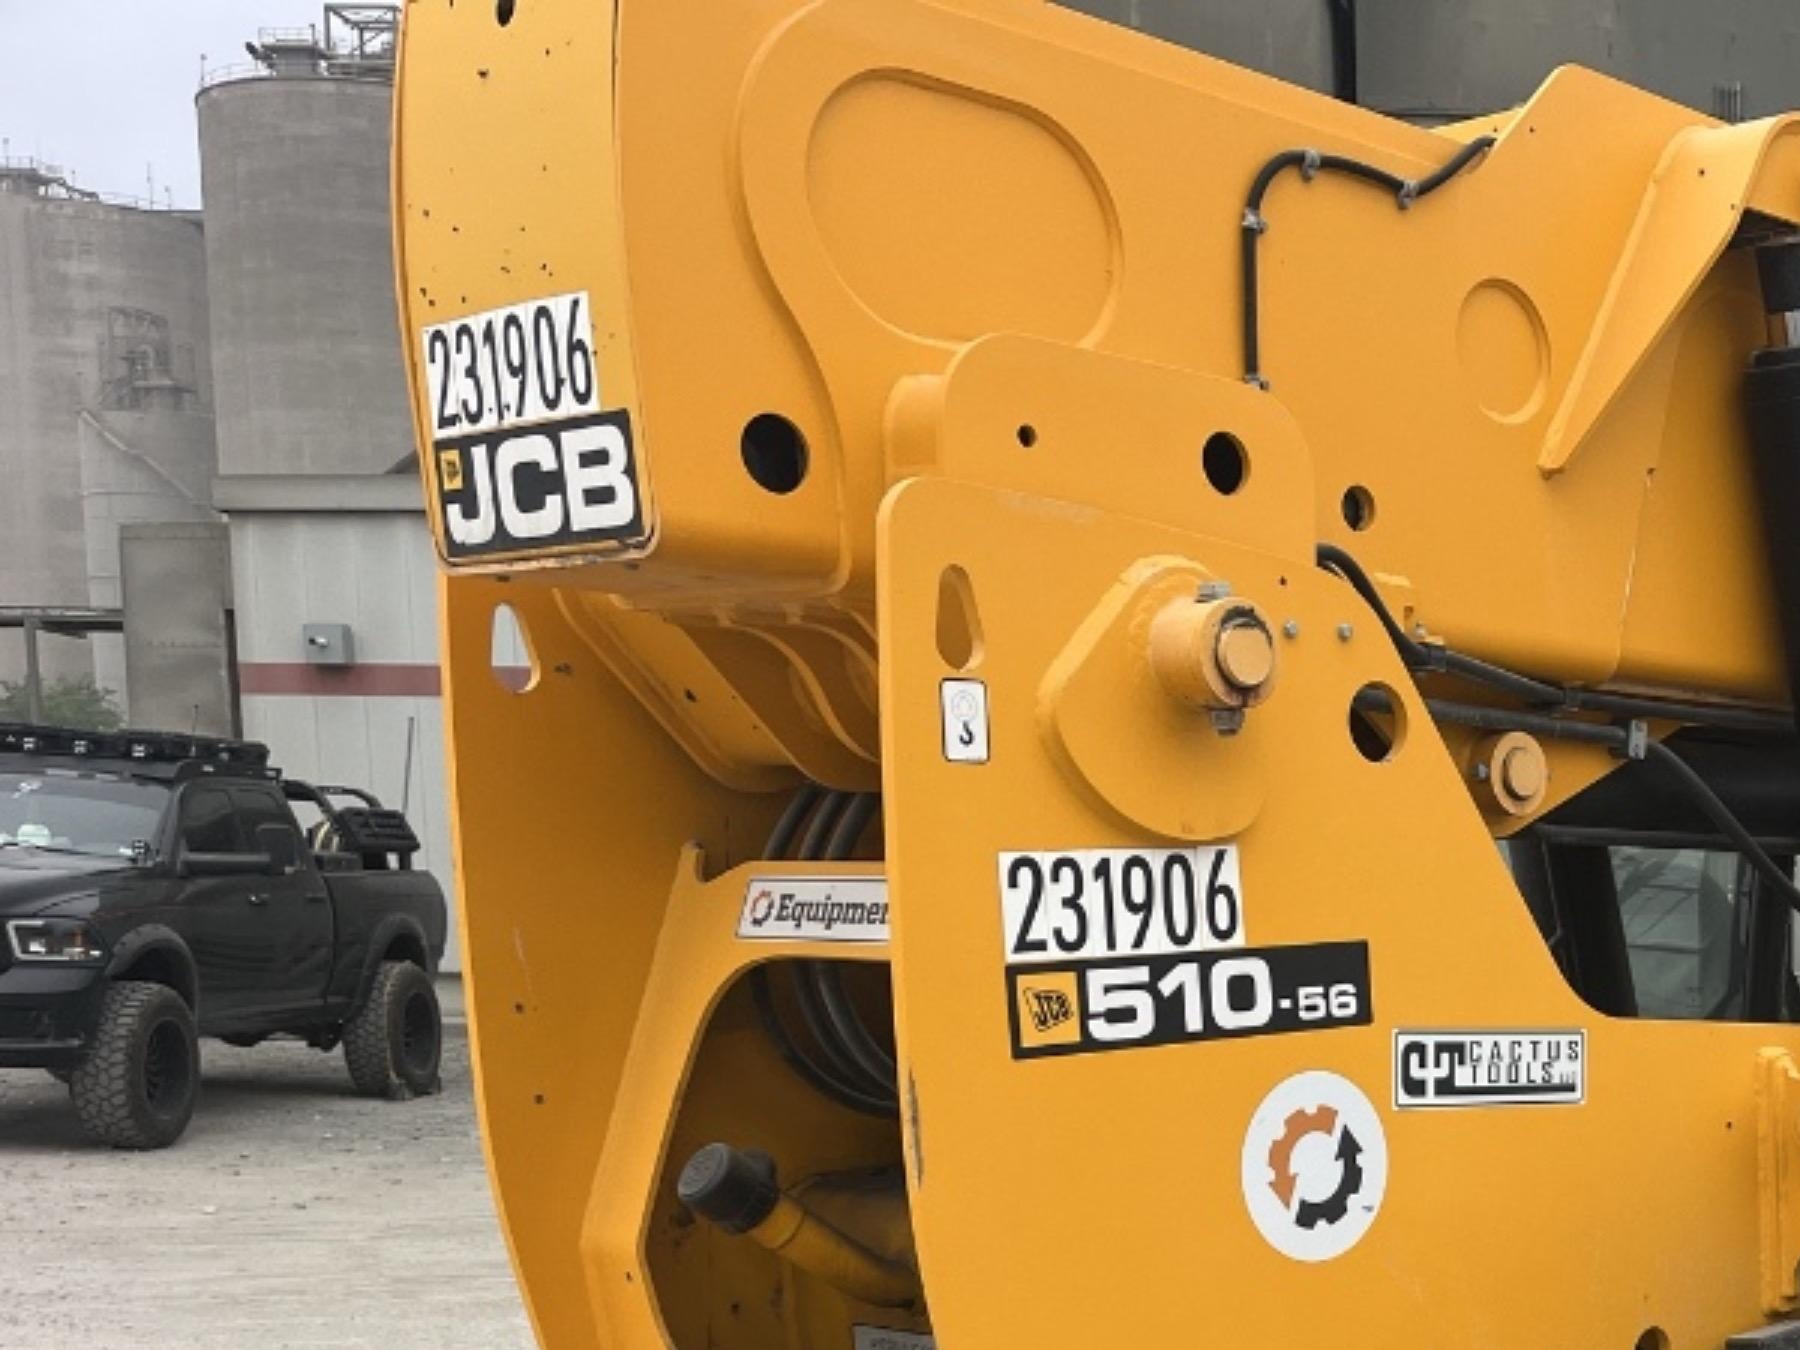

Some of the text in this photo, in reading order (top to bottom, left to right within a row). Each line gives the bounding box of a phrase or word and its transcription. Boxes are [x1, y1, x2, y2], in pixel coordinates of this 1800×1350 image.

[428, 297, 593, 430] 231906
[446, 424, 635, 545] JCB
[1006, 848, 1238, 955] 231906
[1469, 1040, 1580, 1062] CACTUS
[1470, 1062, 1554, 1084] TOOLS
